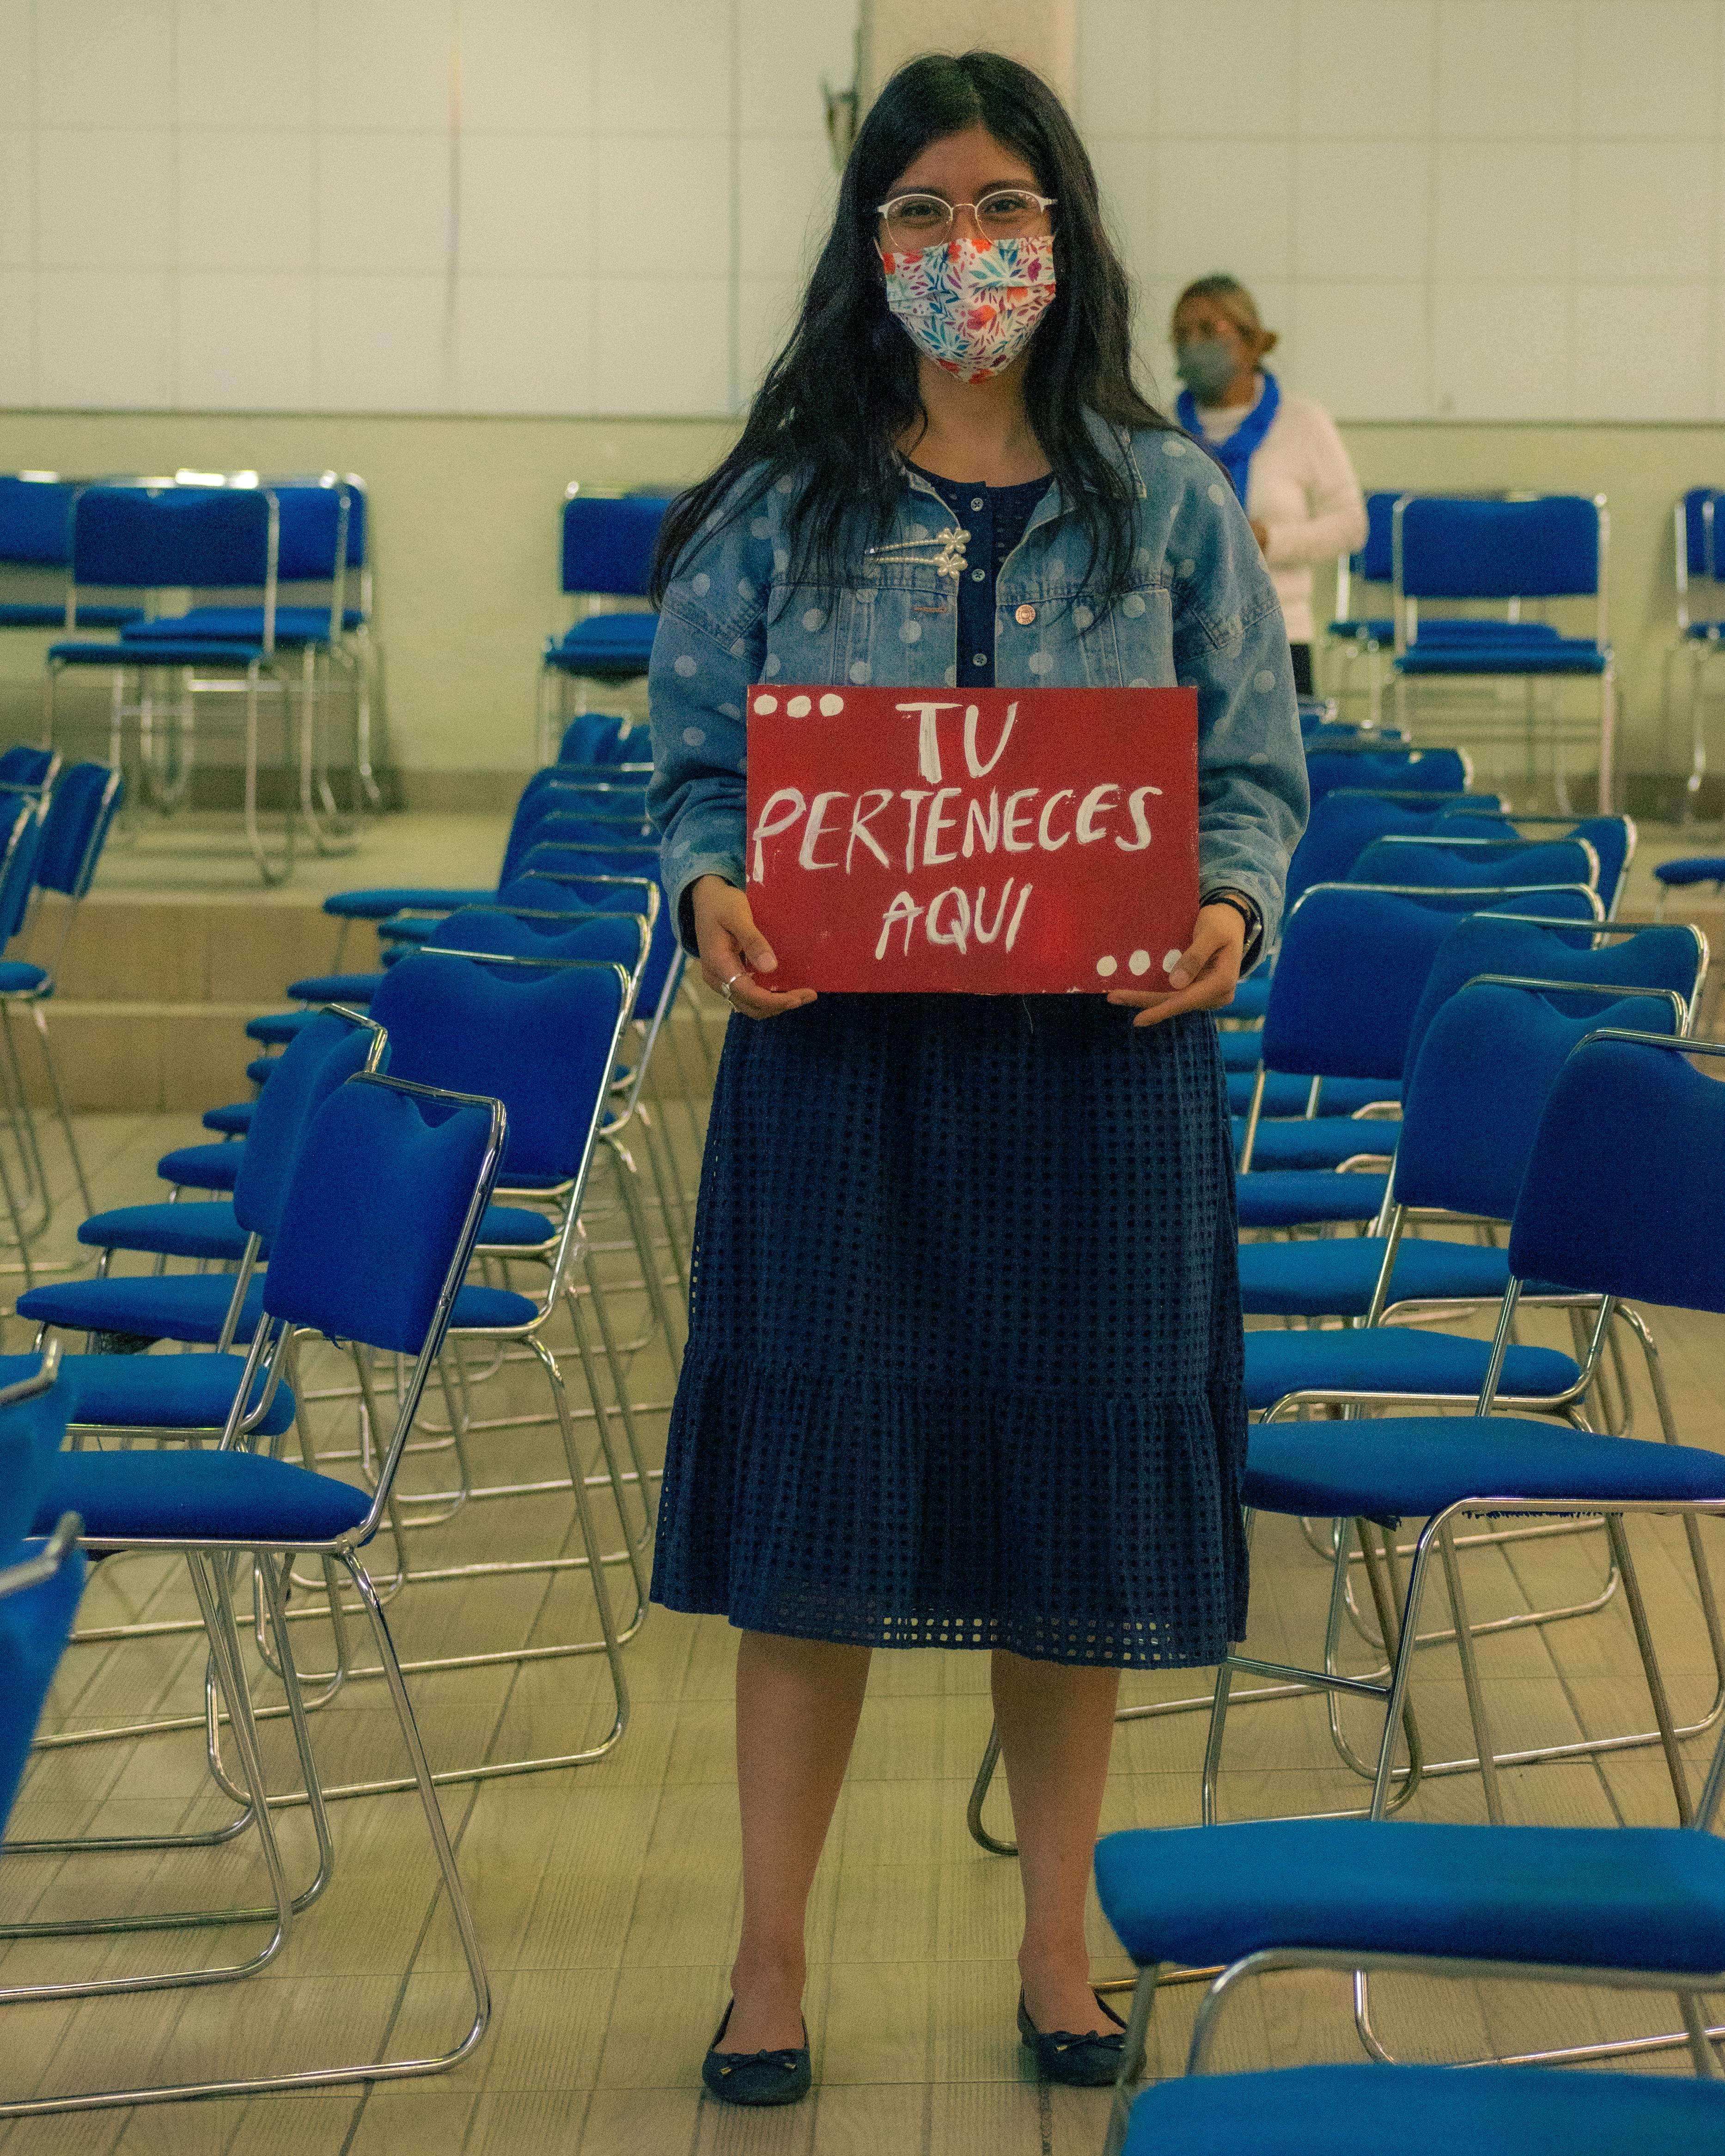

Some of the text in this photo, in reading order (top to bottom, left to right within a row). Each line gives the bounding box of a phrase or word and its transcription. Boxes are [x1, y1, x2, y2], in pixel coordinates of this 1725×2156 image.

[896, 702, 1018, 786] TU
[752, 784, 1163, 884] PERTENECES
[875, 877, 1033, 960] AQUI
